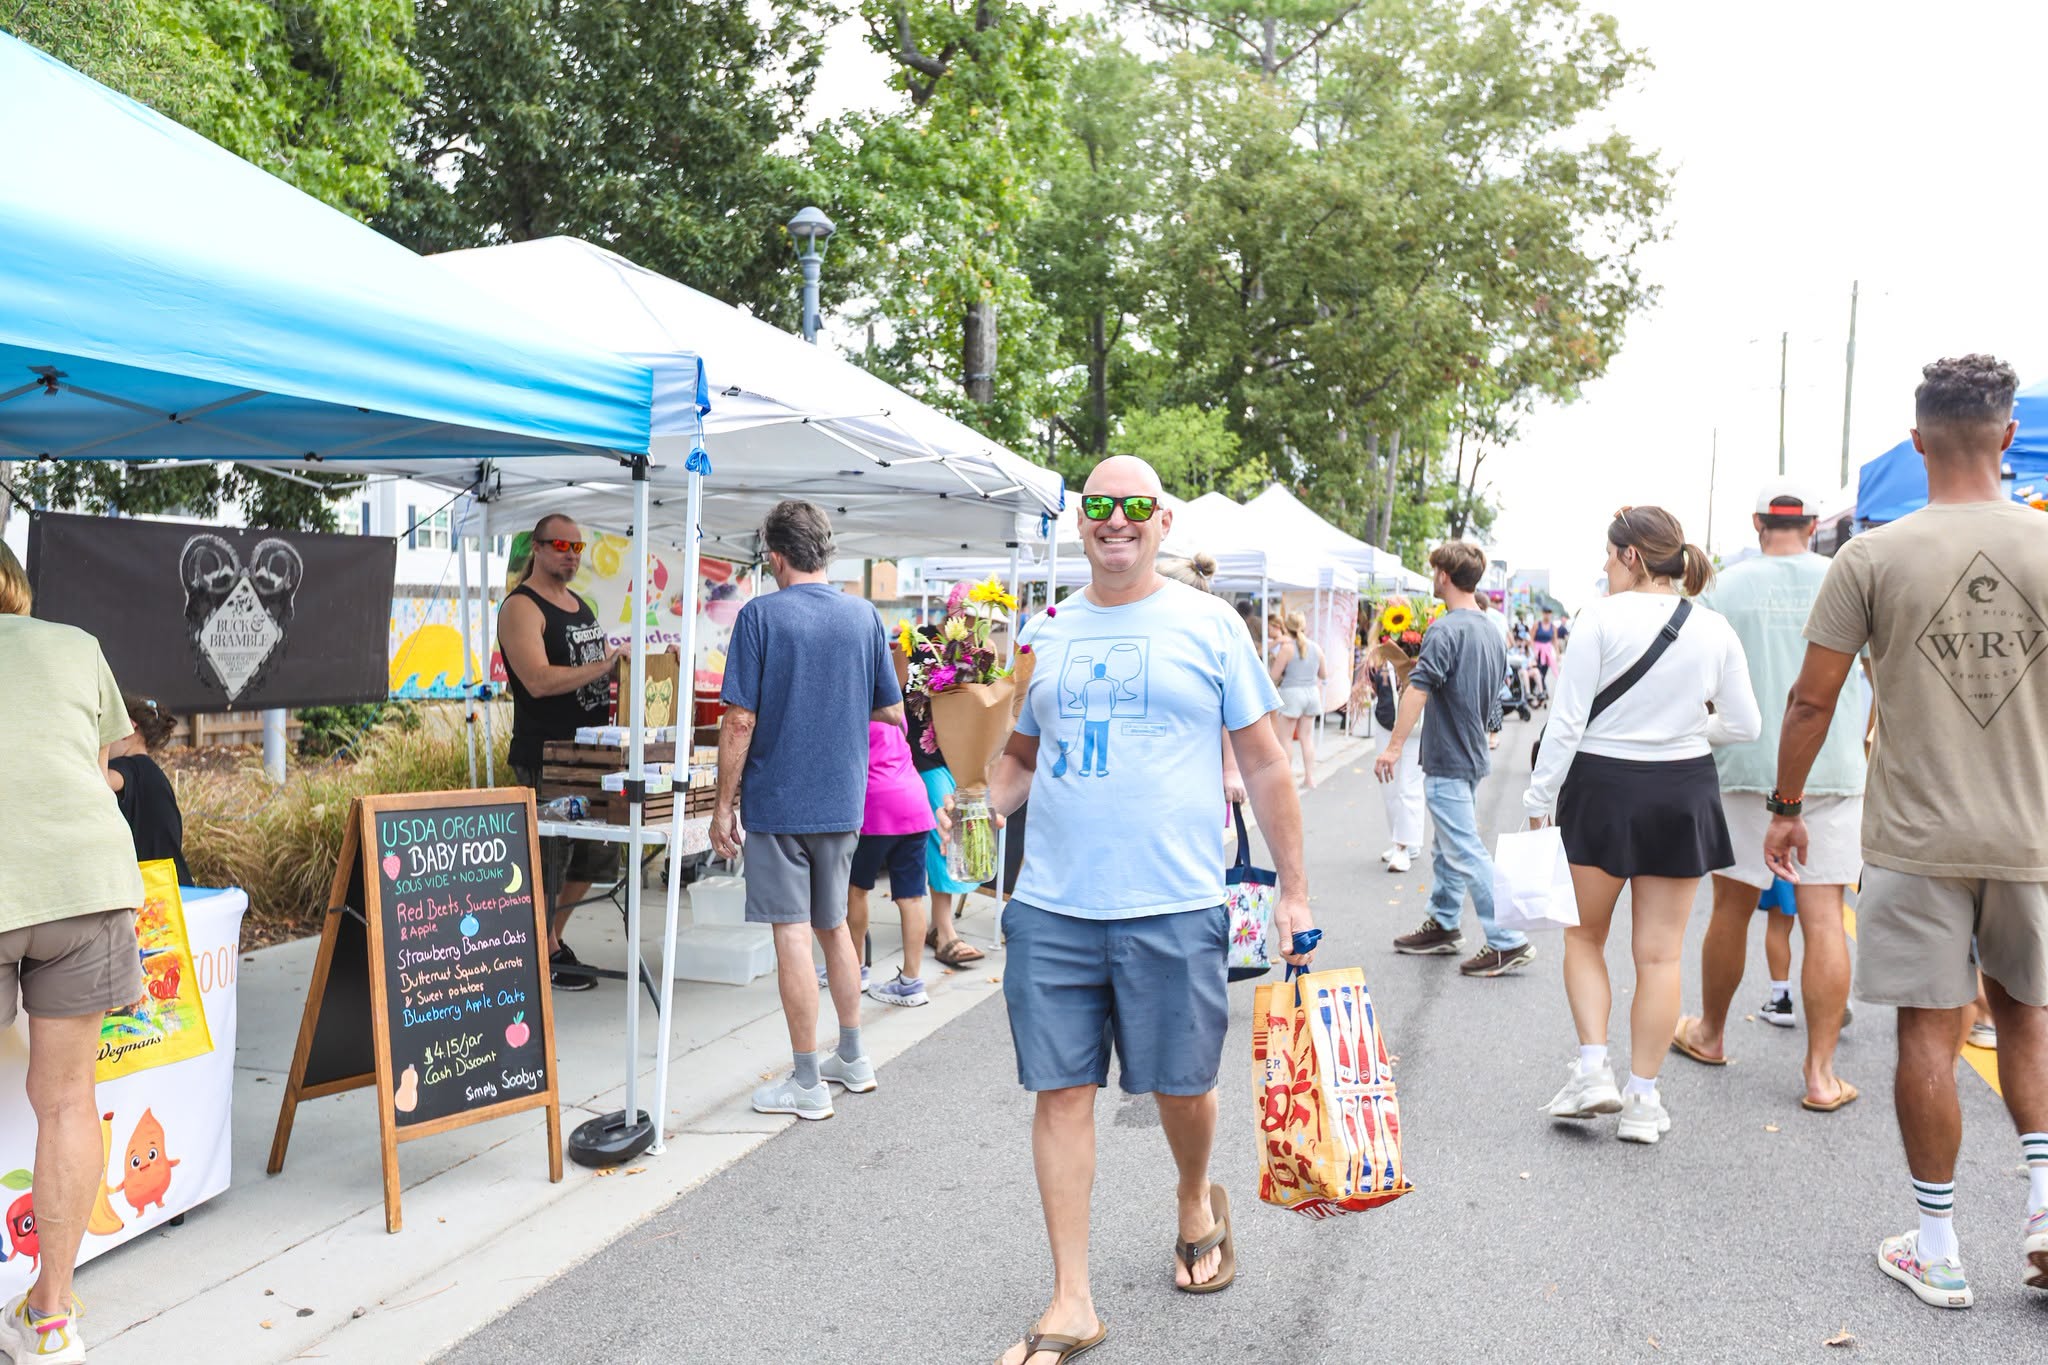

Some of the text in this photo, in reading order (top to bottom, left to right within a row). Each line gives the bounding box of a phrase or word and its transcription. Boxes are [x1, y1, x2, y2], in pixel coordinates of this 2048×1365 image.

[216, 614, 266, 633] BUCK &
[210, 634, 270, 647] BRAMBLE
[382, 812, 518, 847] USDA ORGANIC
[408, 838, 507, 877] BABY FOOD
[395, 878, 423, 895] SOUS
[424, 874, 449, 889] VIDE
[397, 900, 424, 924] Red
[465, 893, 497, 914] Sweet
[410, 922, 438, 941] Apple
[397, 930, 527, 970] Strawberry Banana Oats
[400, 967, 451, 993] Butternut
[493, 956, 523, 971] Carrots
[403, 988, 525, 1028] Blueberry Apple Oats
[417, 990, 444, 1006] Sweet
[425, 1050, 497, 1085] Cash Discount
[465, 1068, 538, 1101] Simply Sooby
